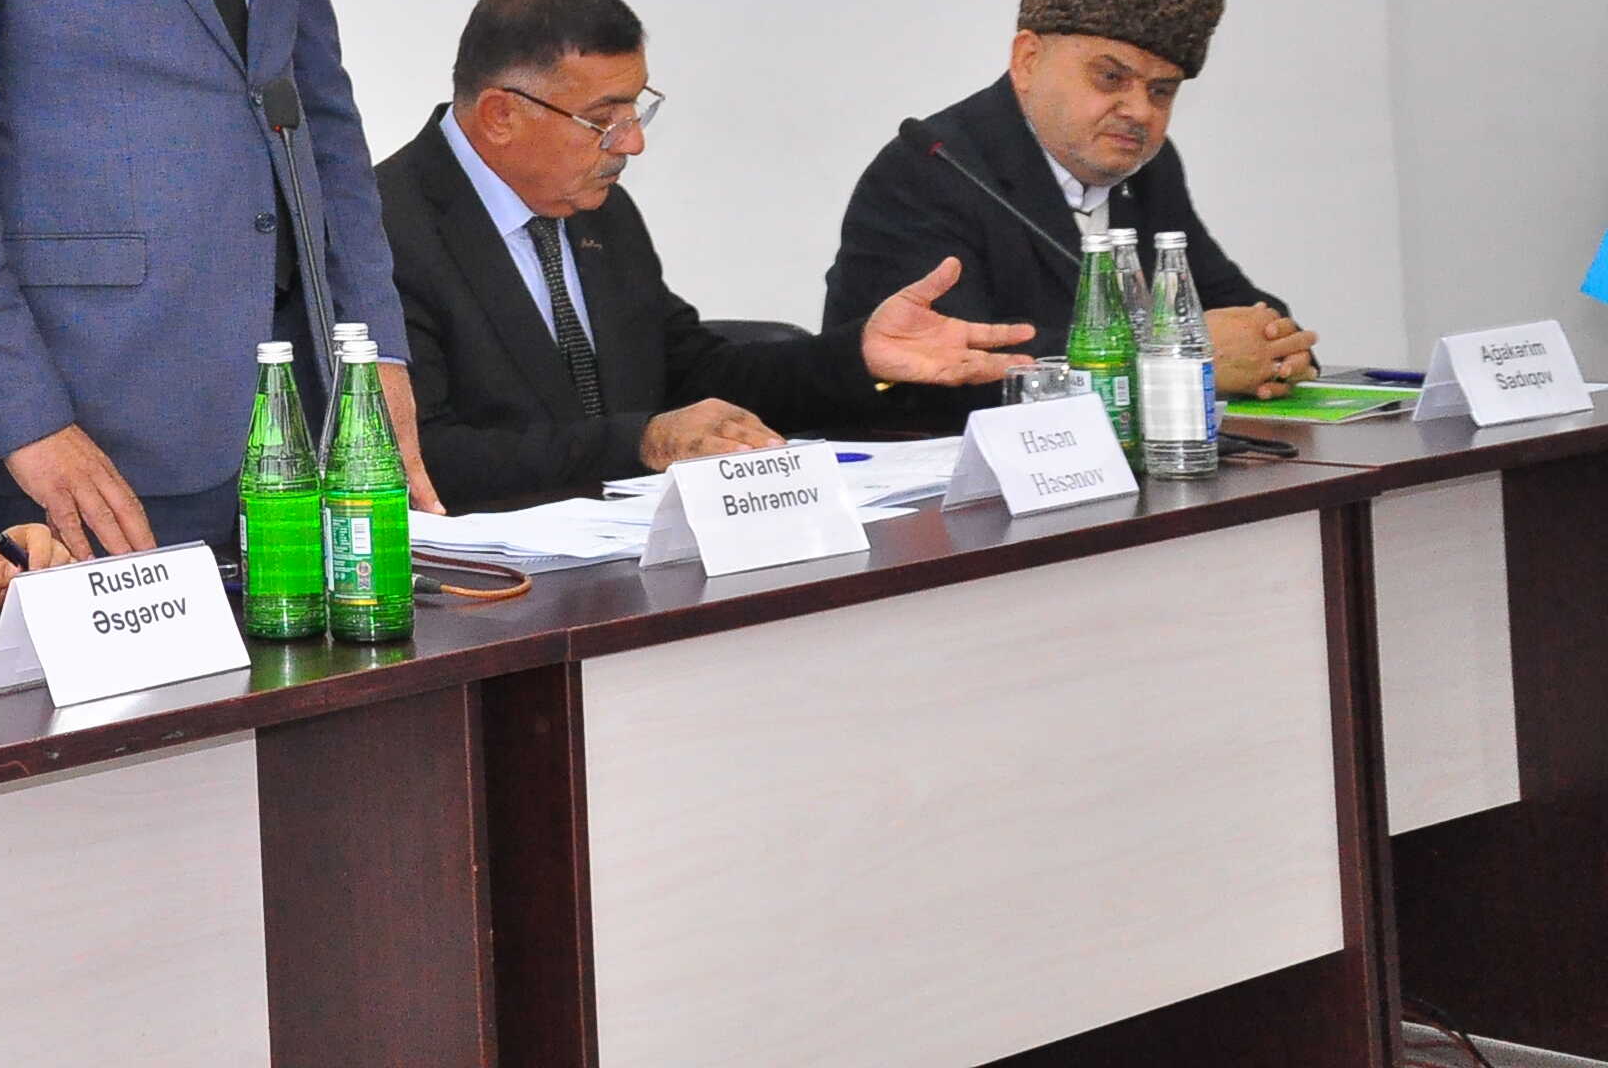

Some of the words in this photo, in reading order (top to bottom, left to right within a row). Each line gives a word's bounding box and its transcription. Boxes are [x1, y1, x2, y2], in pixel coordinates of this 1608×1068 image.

[1020, 429, 1078, 454] Həsən
[718, 450, 802, 481] Cavanşir
[1030, 467, 1105, 496] Həsənov
[722, 487, 819, 517] Bəhrəmov
[87, 562, 170, 597] Ruslan
[91, 596, 188, 634] Əsgərov
